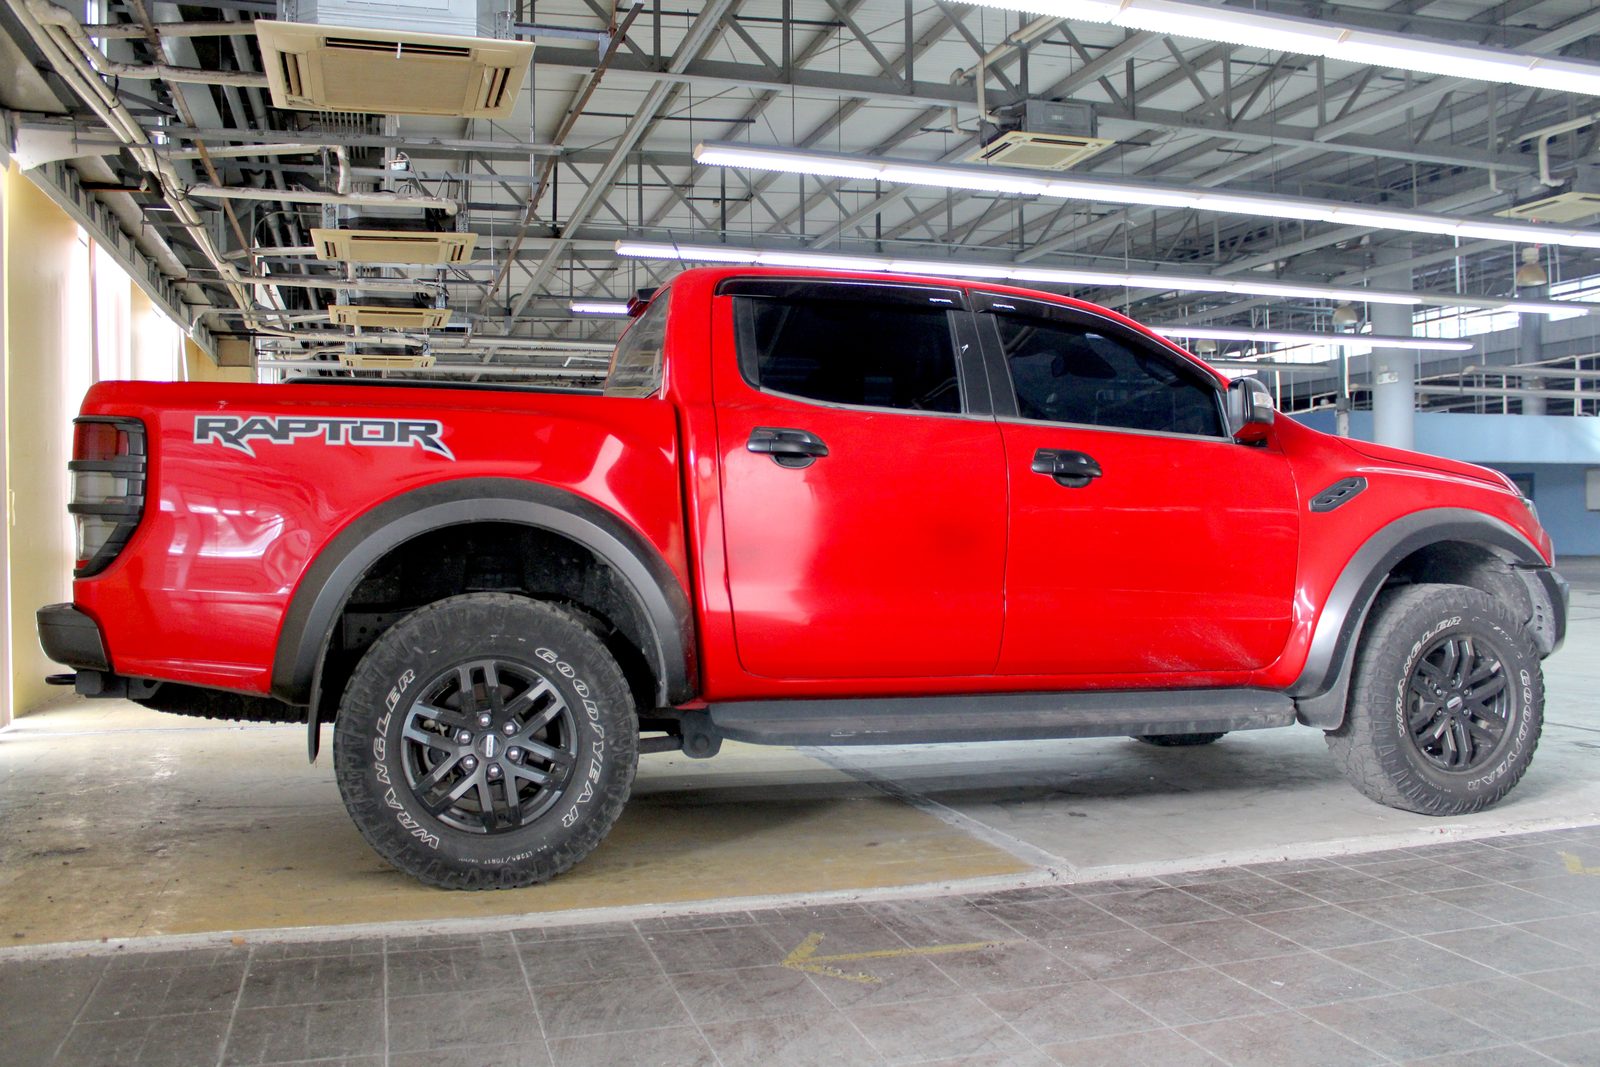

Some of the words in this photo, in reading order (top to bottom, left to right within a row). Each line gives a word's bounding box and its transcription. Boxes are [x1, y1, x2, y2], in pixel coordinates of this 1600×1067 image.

[193, 415, 457, 462] RAPTOR
[535, 647, 604, 828] GOODYEAR
[1396, 616, 1462, 737] WRANGLER
[1467, 669, 1532, 791] GOODYEAR
[373, 669, 440, 850] WRANGLER
